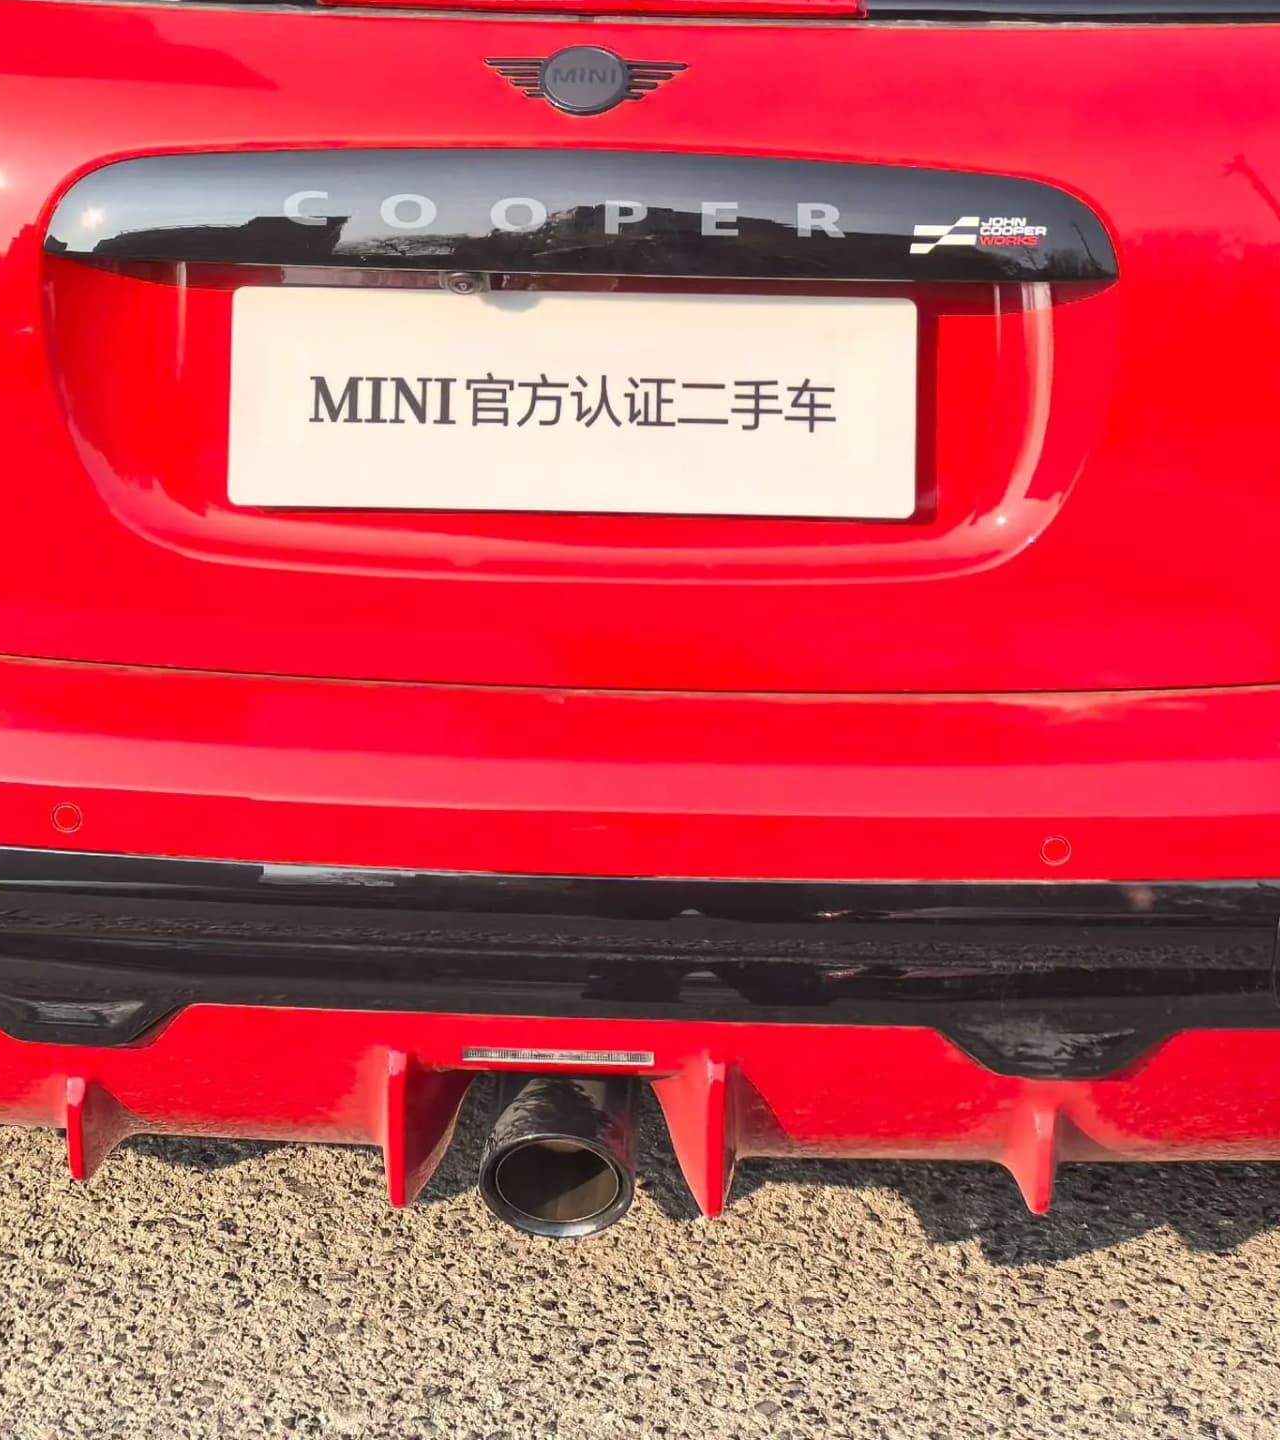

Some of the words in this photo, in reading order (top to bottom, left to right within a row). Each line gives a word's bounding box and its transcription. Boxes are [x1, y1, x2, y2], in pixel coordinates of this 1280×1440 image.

[551, 67, 618, 85] MINI
[284, 190, 846, 237] COOPER
[981, 217, 1027, 226] JOHN
[980, 226, 1048, 236] COOPER
[980, 236, 1039, 246] WORKS
